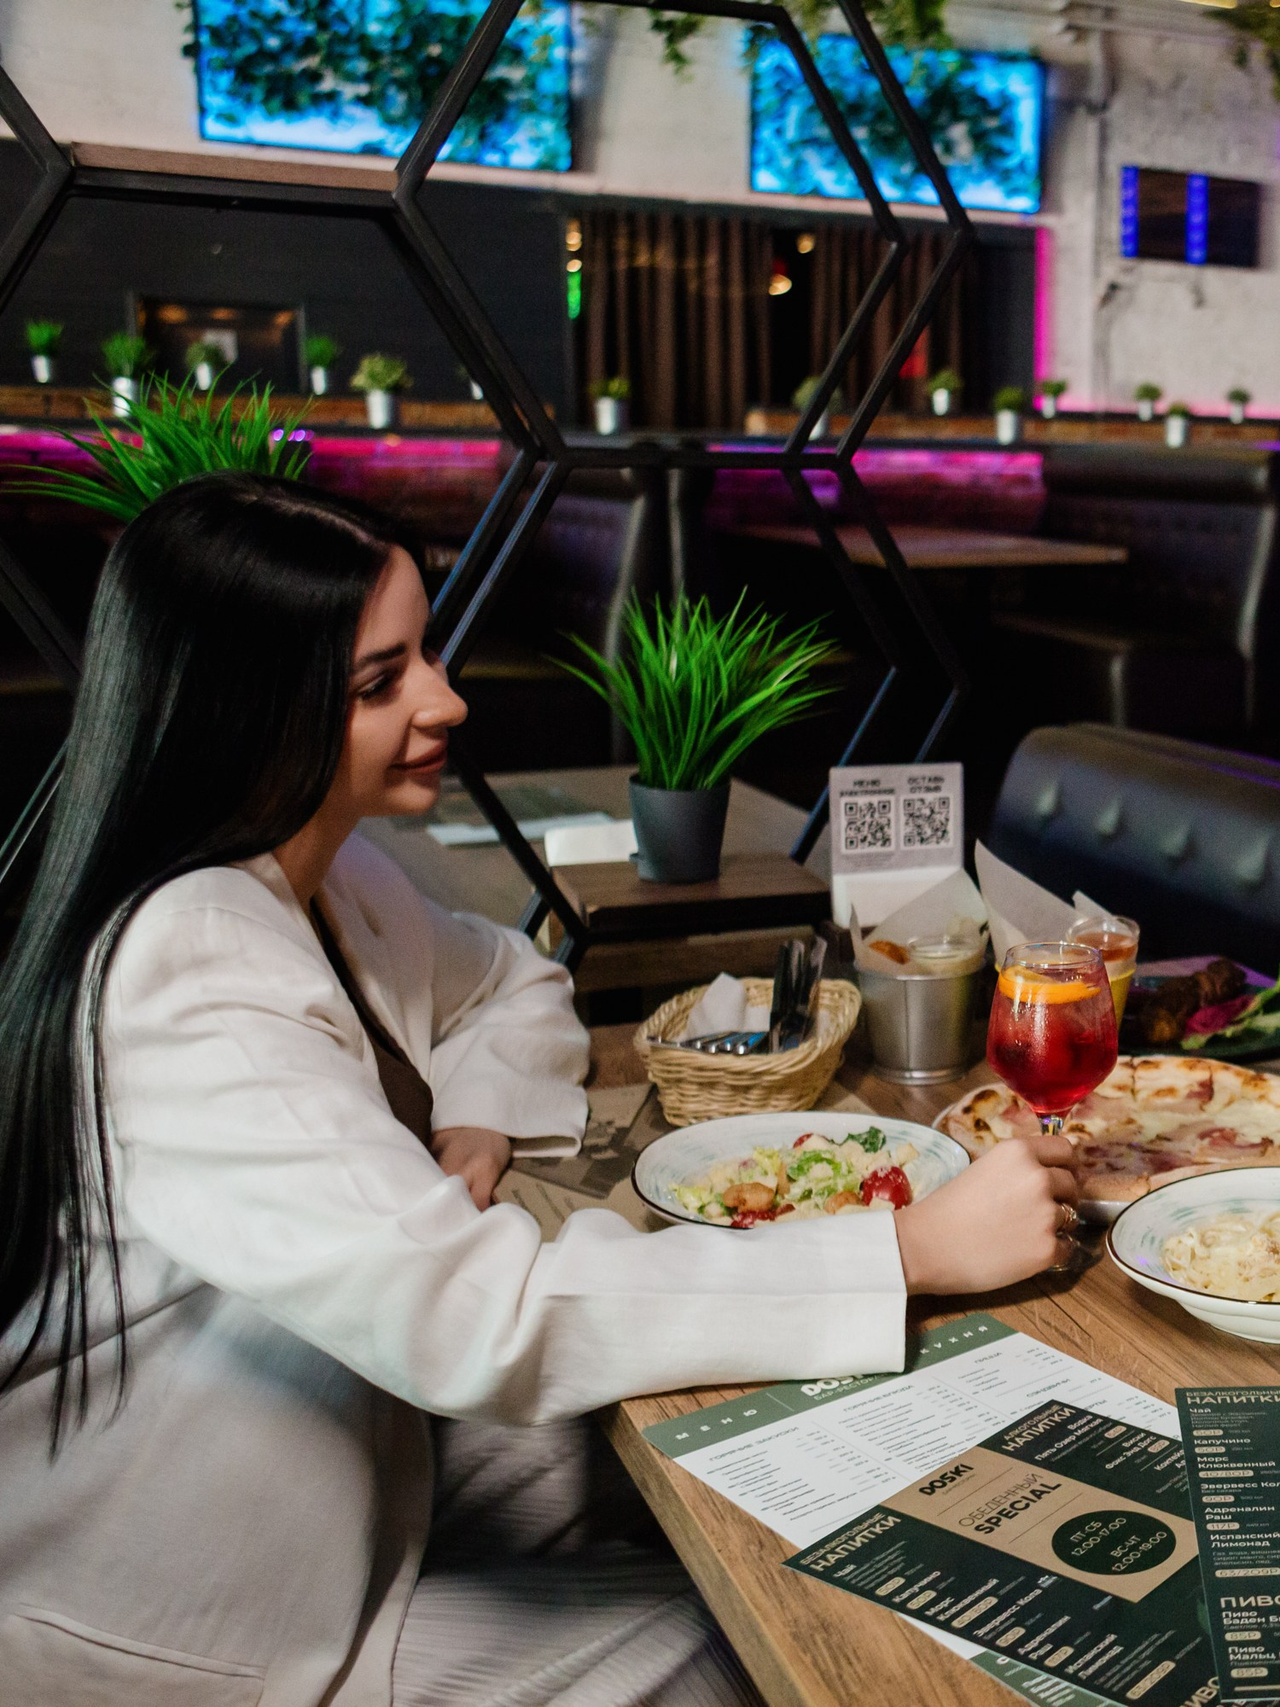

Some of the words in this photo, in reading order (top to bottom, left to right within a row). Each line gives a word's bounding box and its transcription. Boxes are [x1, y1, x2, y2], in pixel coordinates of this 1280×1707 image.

[1002, 1407, 1076, 1451] НАПИТКИ
[1003, 1404, 1063, 1441] АЛКОГОЛЬНЫЕ
[1198, 1461, 1276, 1469] Клюквенный
[918, 1463, 974, 1496] DOSKI
[958, 1473, 1043, 1527] ОБЕДЕННЫЙ
[974, 1482, 1062, 1534] SPECIAL
[1205, 1506, 1275, 1514] Адреналин
[800, 1512, 886, 1565] БЕЗАЛКОГОЛЬНЫЕ
[1070, 1520, 1102, 1543] ПТ-СБ
[1210, 1532, 1280, 1540] Испанский
[809, 1515, 902, 1572] НАПИТКИ
[1110, 1535, 1141, 1558] ВС-ЧТ
[1211, 1540, 1270, 1548] Лимонад
[1223, 1617, 1266, 1625] Баден
[1228, 1646, 1265, 1654] Пиво
[1229, 1652, 1276, 1661] Мальц
